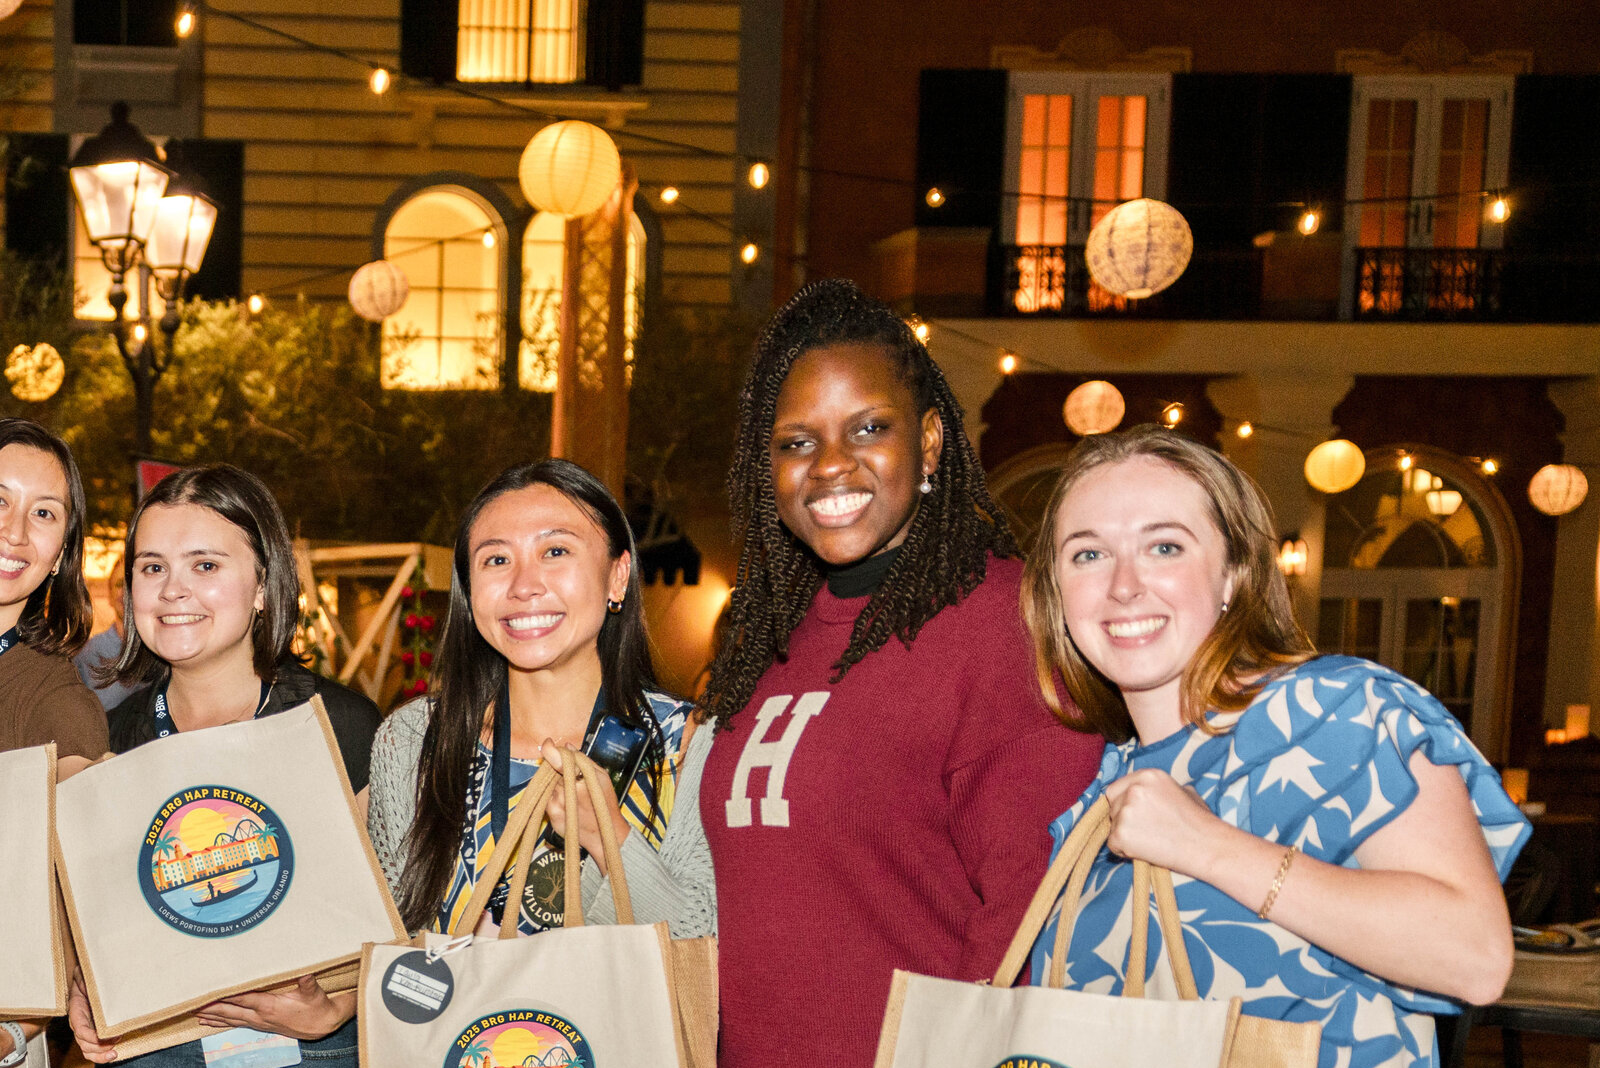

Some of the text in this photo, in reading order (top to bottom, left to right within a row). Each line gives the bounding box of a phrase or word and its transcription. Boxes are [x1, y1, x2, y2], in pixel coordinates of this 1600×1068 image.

[725, 691, 831, 828] H
[146, 789, 266, 845] 2025 BRG HAP RETREAT
[159, 869, 289, 934] LOEWS PORTOFINO BAY UNIVERSAL ORLANDO
[524, 885, 565, 924] WILLOW
[457, 1012, 582, 1049] 2025 BRG HAP RETREAT
